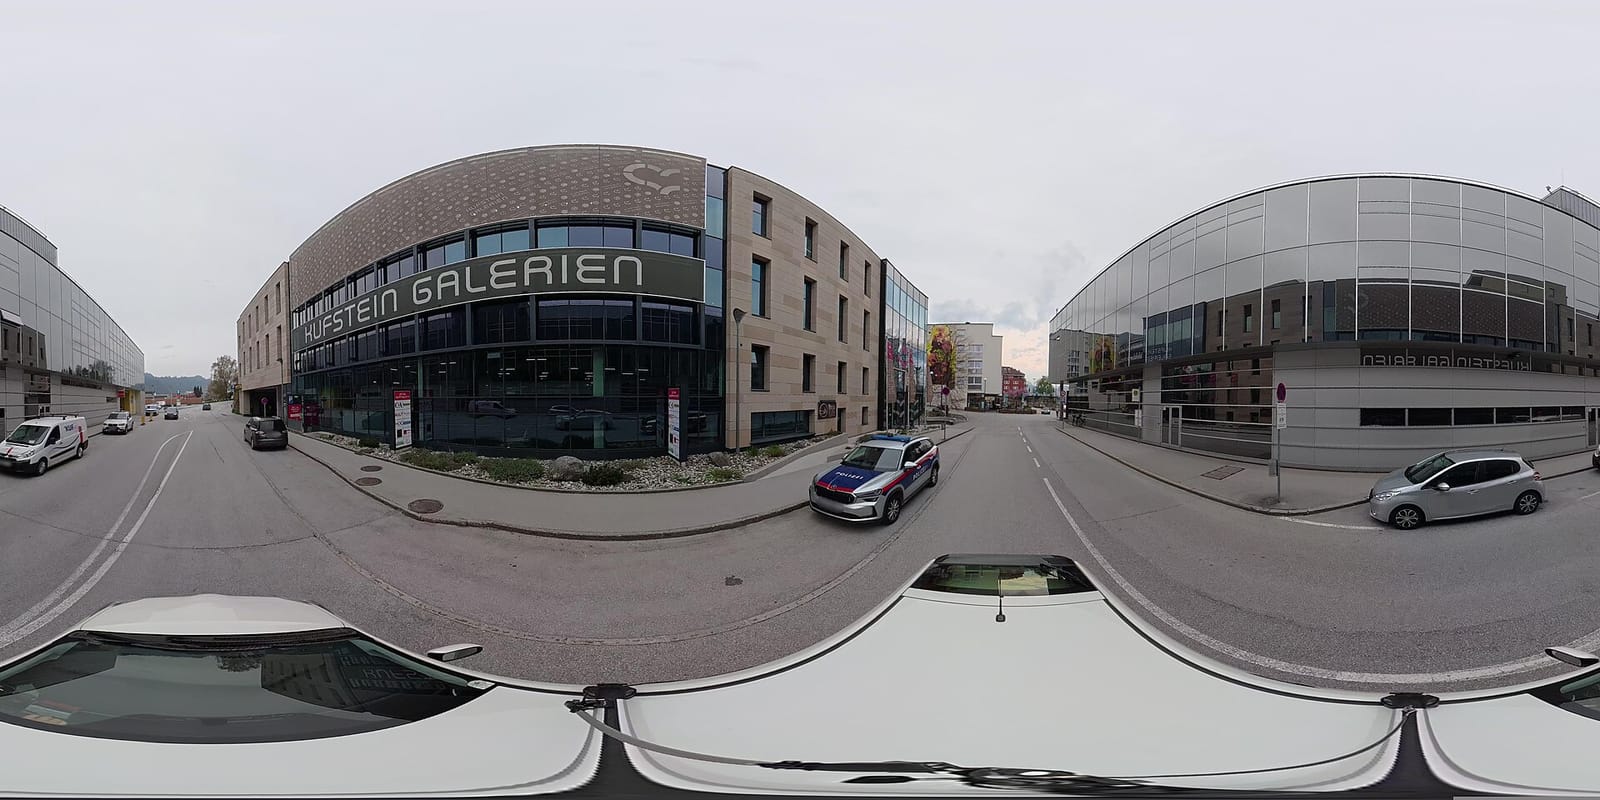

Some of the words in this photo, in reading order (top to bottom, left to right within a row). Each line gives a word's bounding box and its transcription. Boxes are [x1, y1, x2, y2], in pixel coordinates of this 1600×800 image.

[304, 289, 397, 344] KUFSTEIN
[412, 254, 643, 305] GALERIEN
[835, 471, 864, 480] POLIZEI
